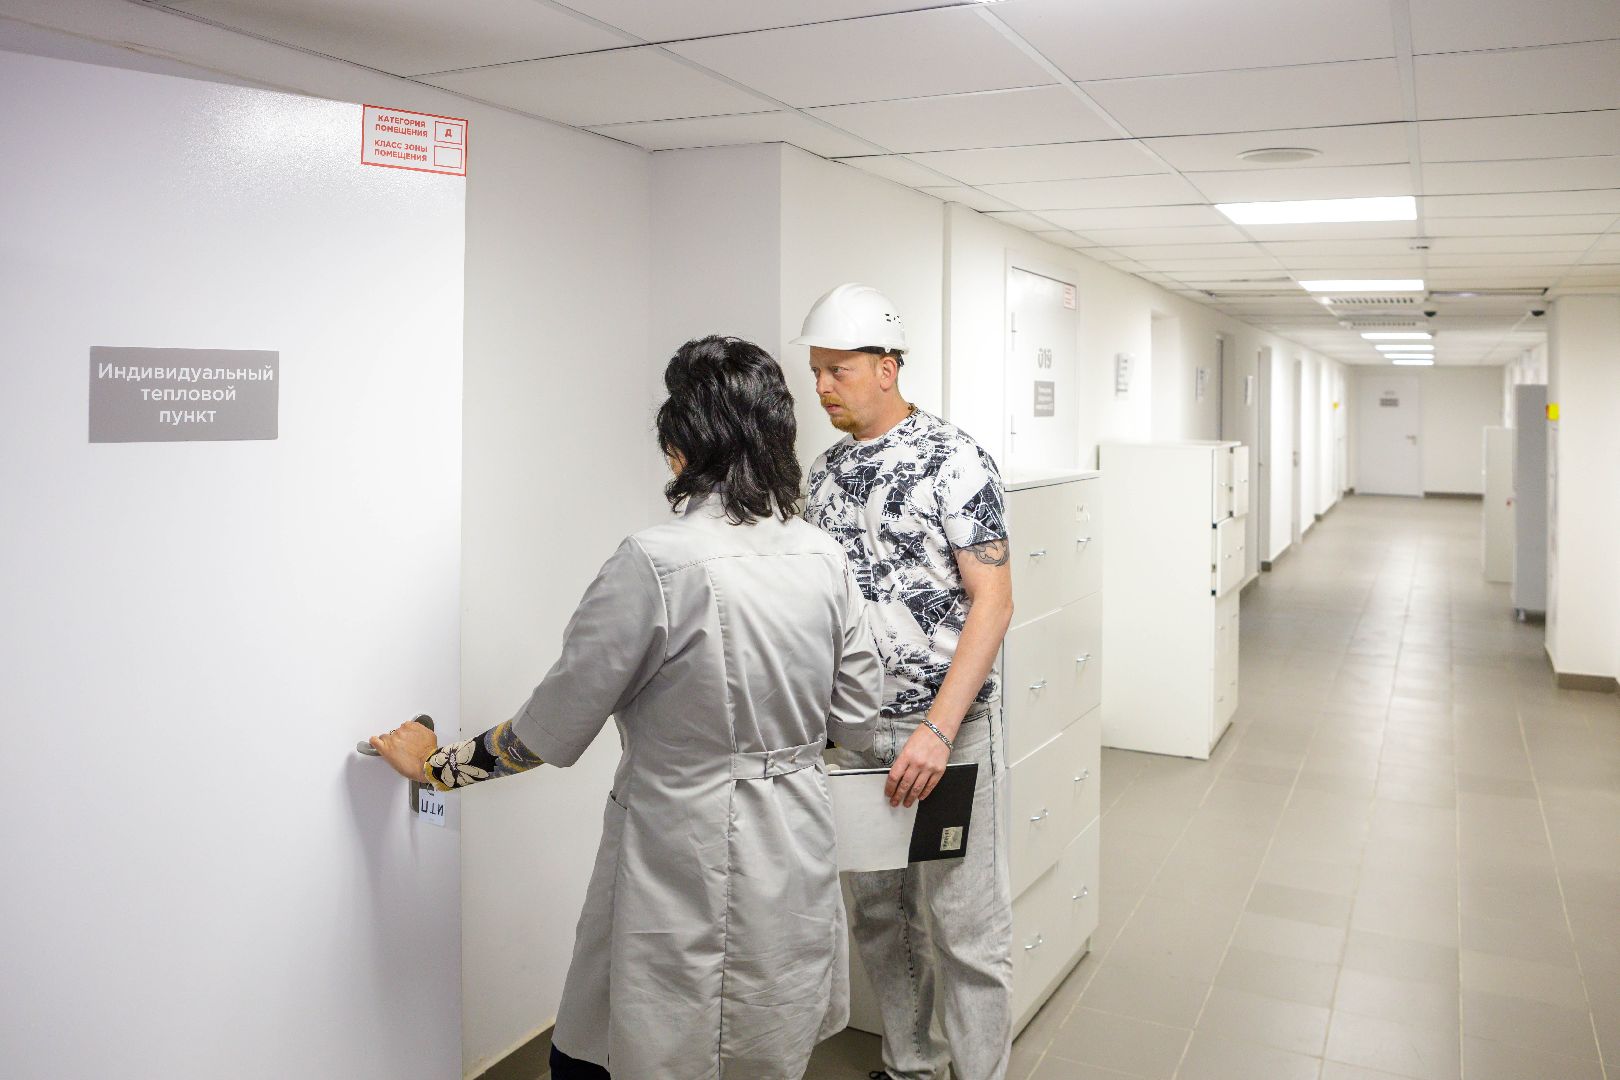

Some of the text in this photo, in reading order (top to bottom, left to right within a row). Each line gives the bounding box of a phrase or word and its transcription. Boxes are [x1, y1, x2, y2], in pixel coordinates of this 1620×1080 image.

[378, 114, 426, 128] КАТЕГОРИЯ
[375, 123, 428, 138] ПОМЕЩЕНИЯ
[444, 128, 453, 138] Д
[374, 139, 428, 153] КЛАСС ЗОНЫ
[374, 148, 427, 162] ПОМЕЩЕНИЯ
[98, 362, 274, 383] Индивидуальный
[140, 385, 236, 401] тепловой
[159, 410, 217, 426] пункт
